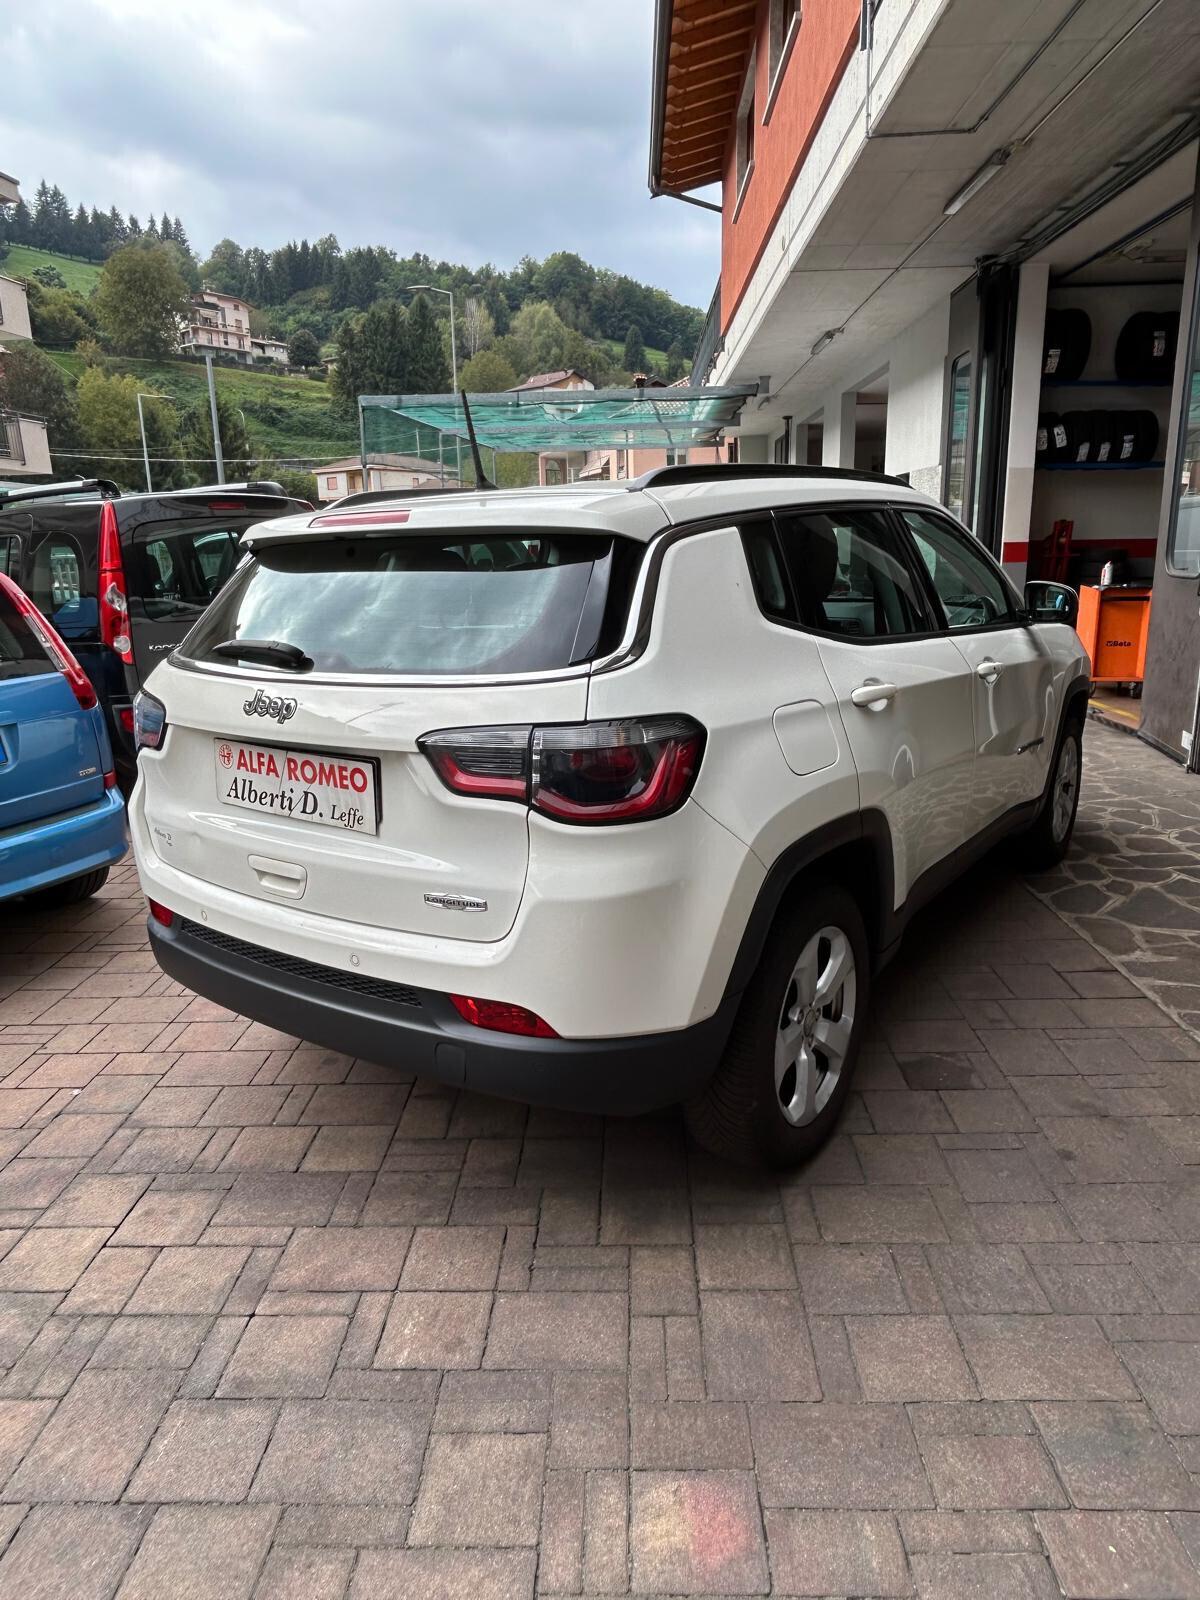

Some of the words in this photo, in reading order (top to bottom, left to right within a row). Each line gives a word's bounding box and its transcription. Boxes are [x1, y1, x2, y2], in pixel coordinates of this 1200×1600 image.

[242, 689, 298, 724] Jeep
[236, 748, 280, 778] ALFA
[286, 755, 368, 793] ROMEO
[226, 776, 295, 813] Alberti
[300, 790, 324, 818] D.
[331, 804, 364, 829] Leffe
[426, 896, 482, 909] LONGITUDE
